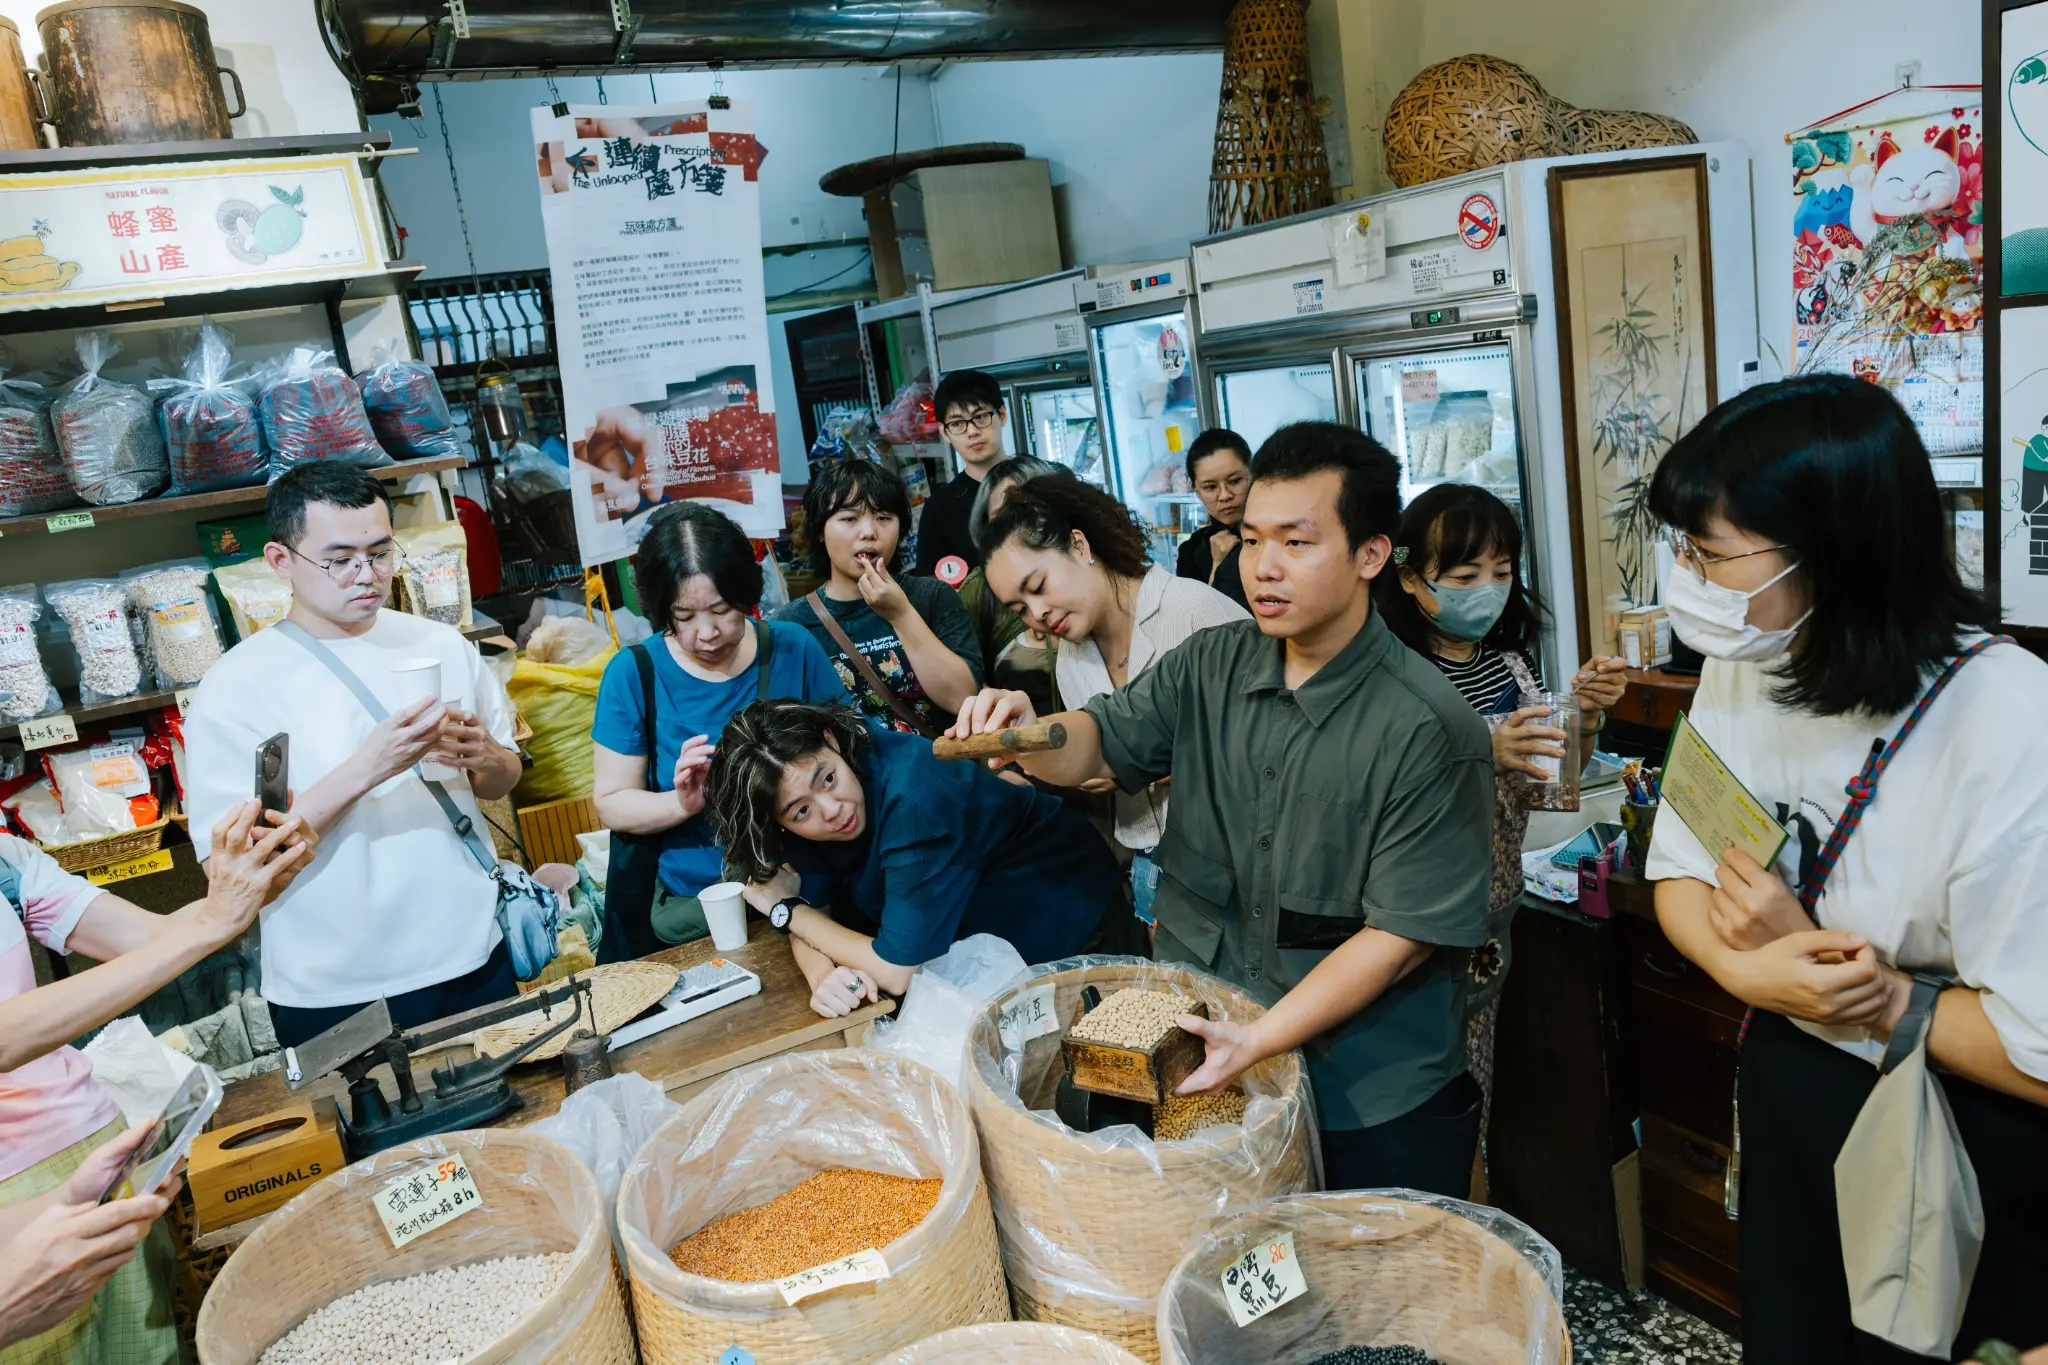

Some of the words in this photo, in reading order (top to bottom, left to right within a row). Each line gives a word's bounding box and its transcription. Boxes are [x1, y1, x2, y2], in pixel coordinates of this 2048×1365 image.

[664, 144, 727, 158] Prescription
[105, 190, 140, 199] NATURAL
[140, 187, 169, 195] FLAVOR
[573, 176, 590, 189] The
[593, 170, 644, 188] Unlooped
[107, 205, 178, 238] 蜂蜜
[120, 244, 189, 273] 山產
[224, 1163, 322, 1203] ORIGINALS
[388, 1173, 439, 1213] 雪蓮子
[438, 1161, 456, 1182] 50
[1269, 1242, 1287, 1265] 80
[1239, 1267, 1288, 1316] 黑豆
